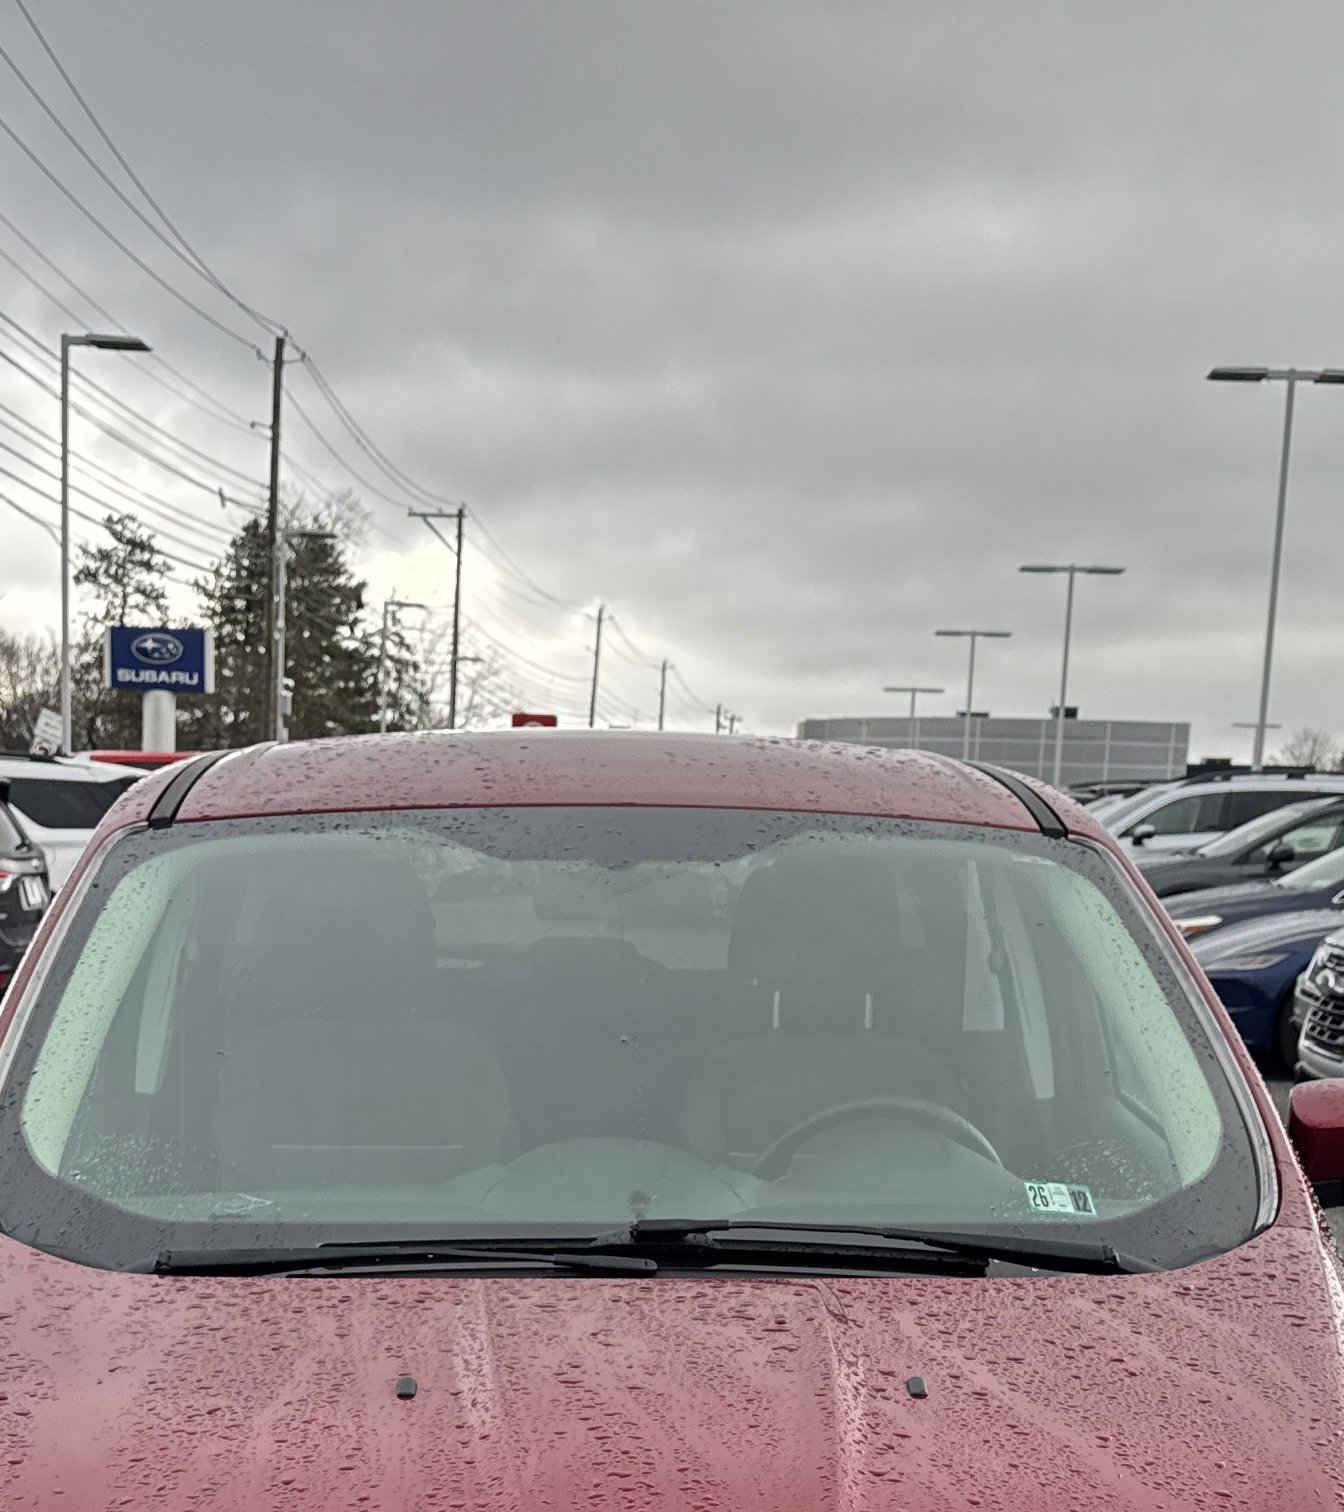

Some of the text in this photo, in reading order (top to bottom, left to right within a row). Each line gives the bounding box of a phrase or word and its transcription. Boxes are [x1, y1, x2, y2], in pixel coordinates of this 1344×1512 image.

[117, 668, 199, 685] SUBARU
[1028, 1185, 1093, 1213] 26 12
